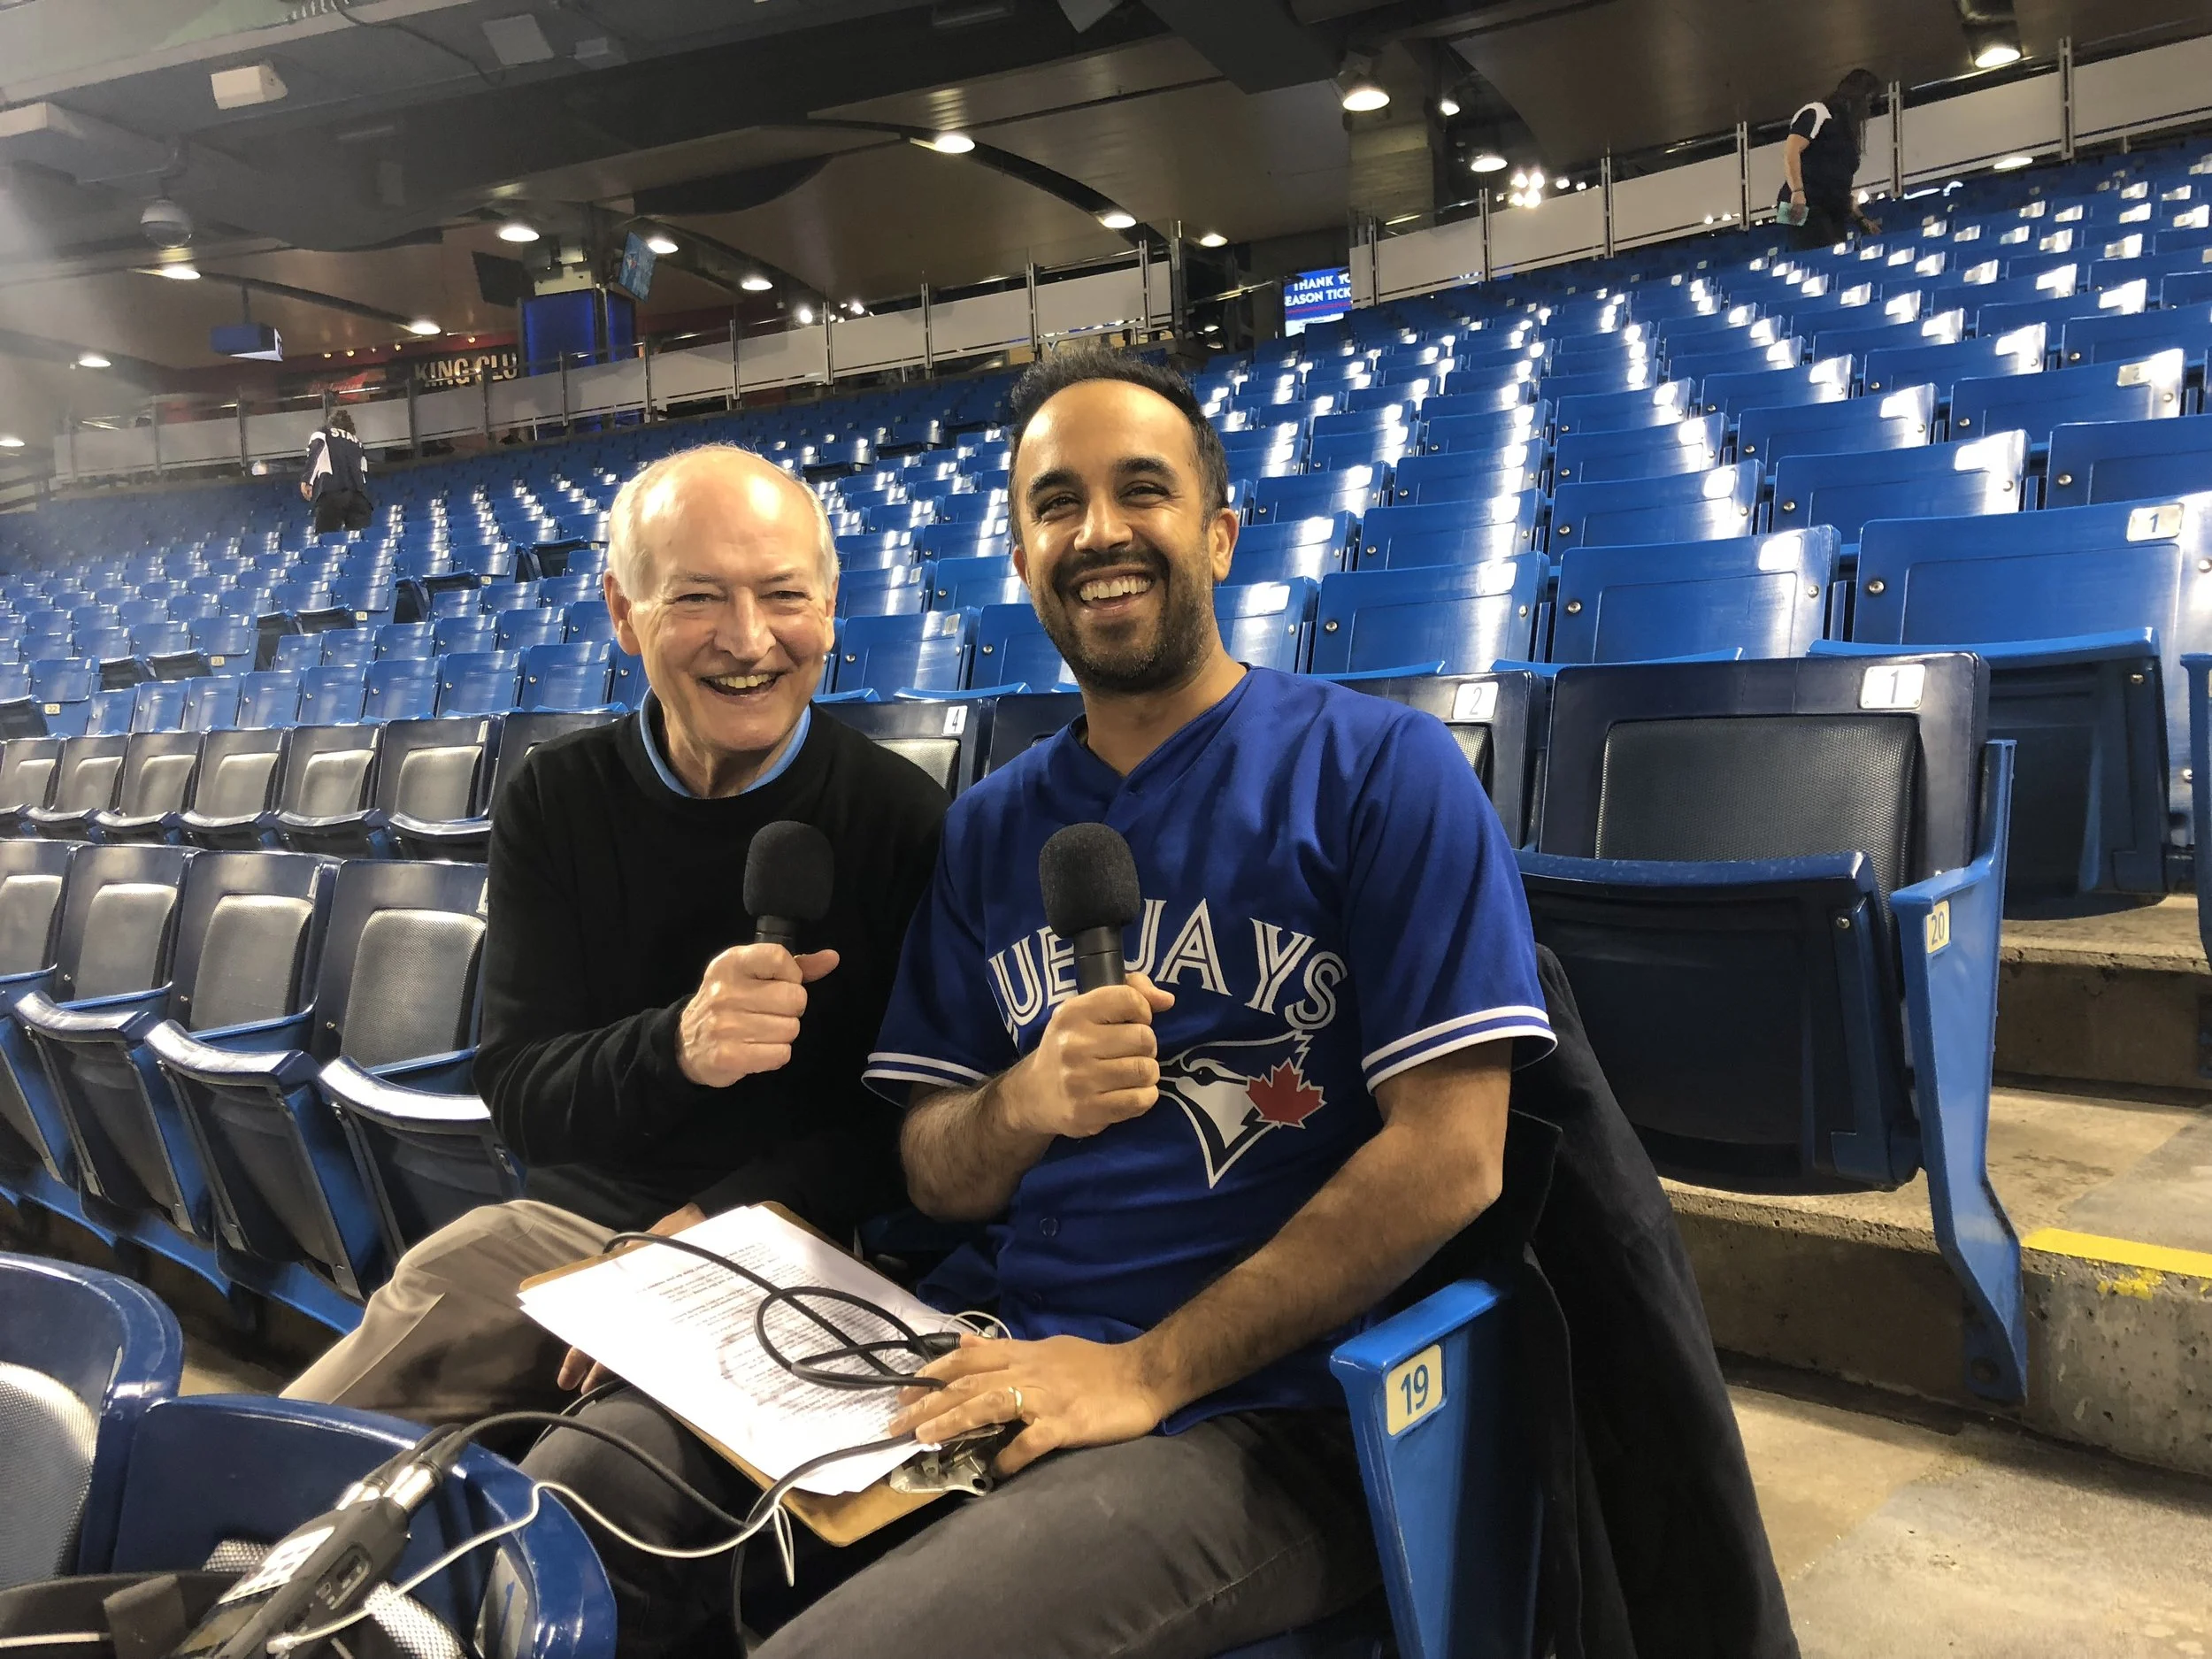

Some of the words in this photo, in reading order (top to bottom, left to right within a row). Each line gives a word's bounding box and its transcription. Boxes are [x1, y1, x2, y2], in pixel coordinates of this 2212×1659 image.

[415, 357, 470, 388] KING
[2149, 512, 2160, 533] 1
[1469, 686, 1483, 715] 2
[1890, 669, 1900, 704] 1
[951, 708, 960, 733] 4
[1932, 910, 1945, 946] 20
[987, 926, 1079, 1032] UE
[1124, 897, 1348, 1031] JAYS
[1400, 1363, 1429, 1416] 19
